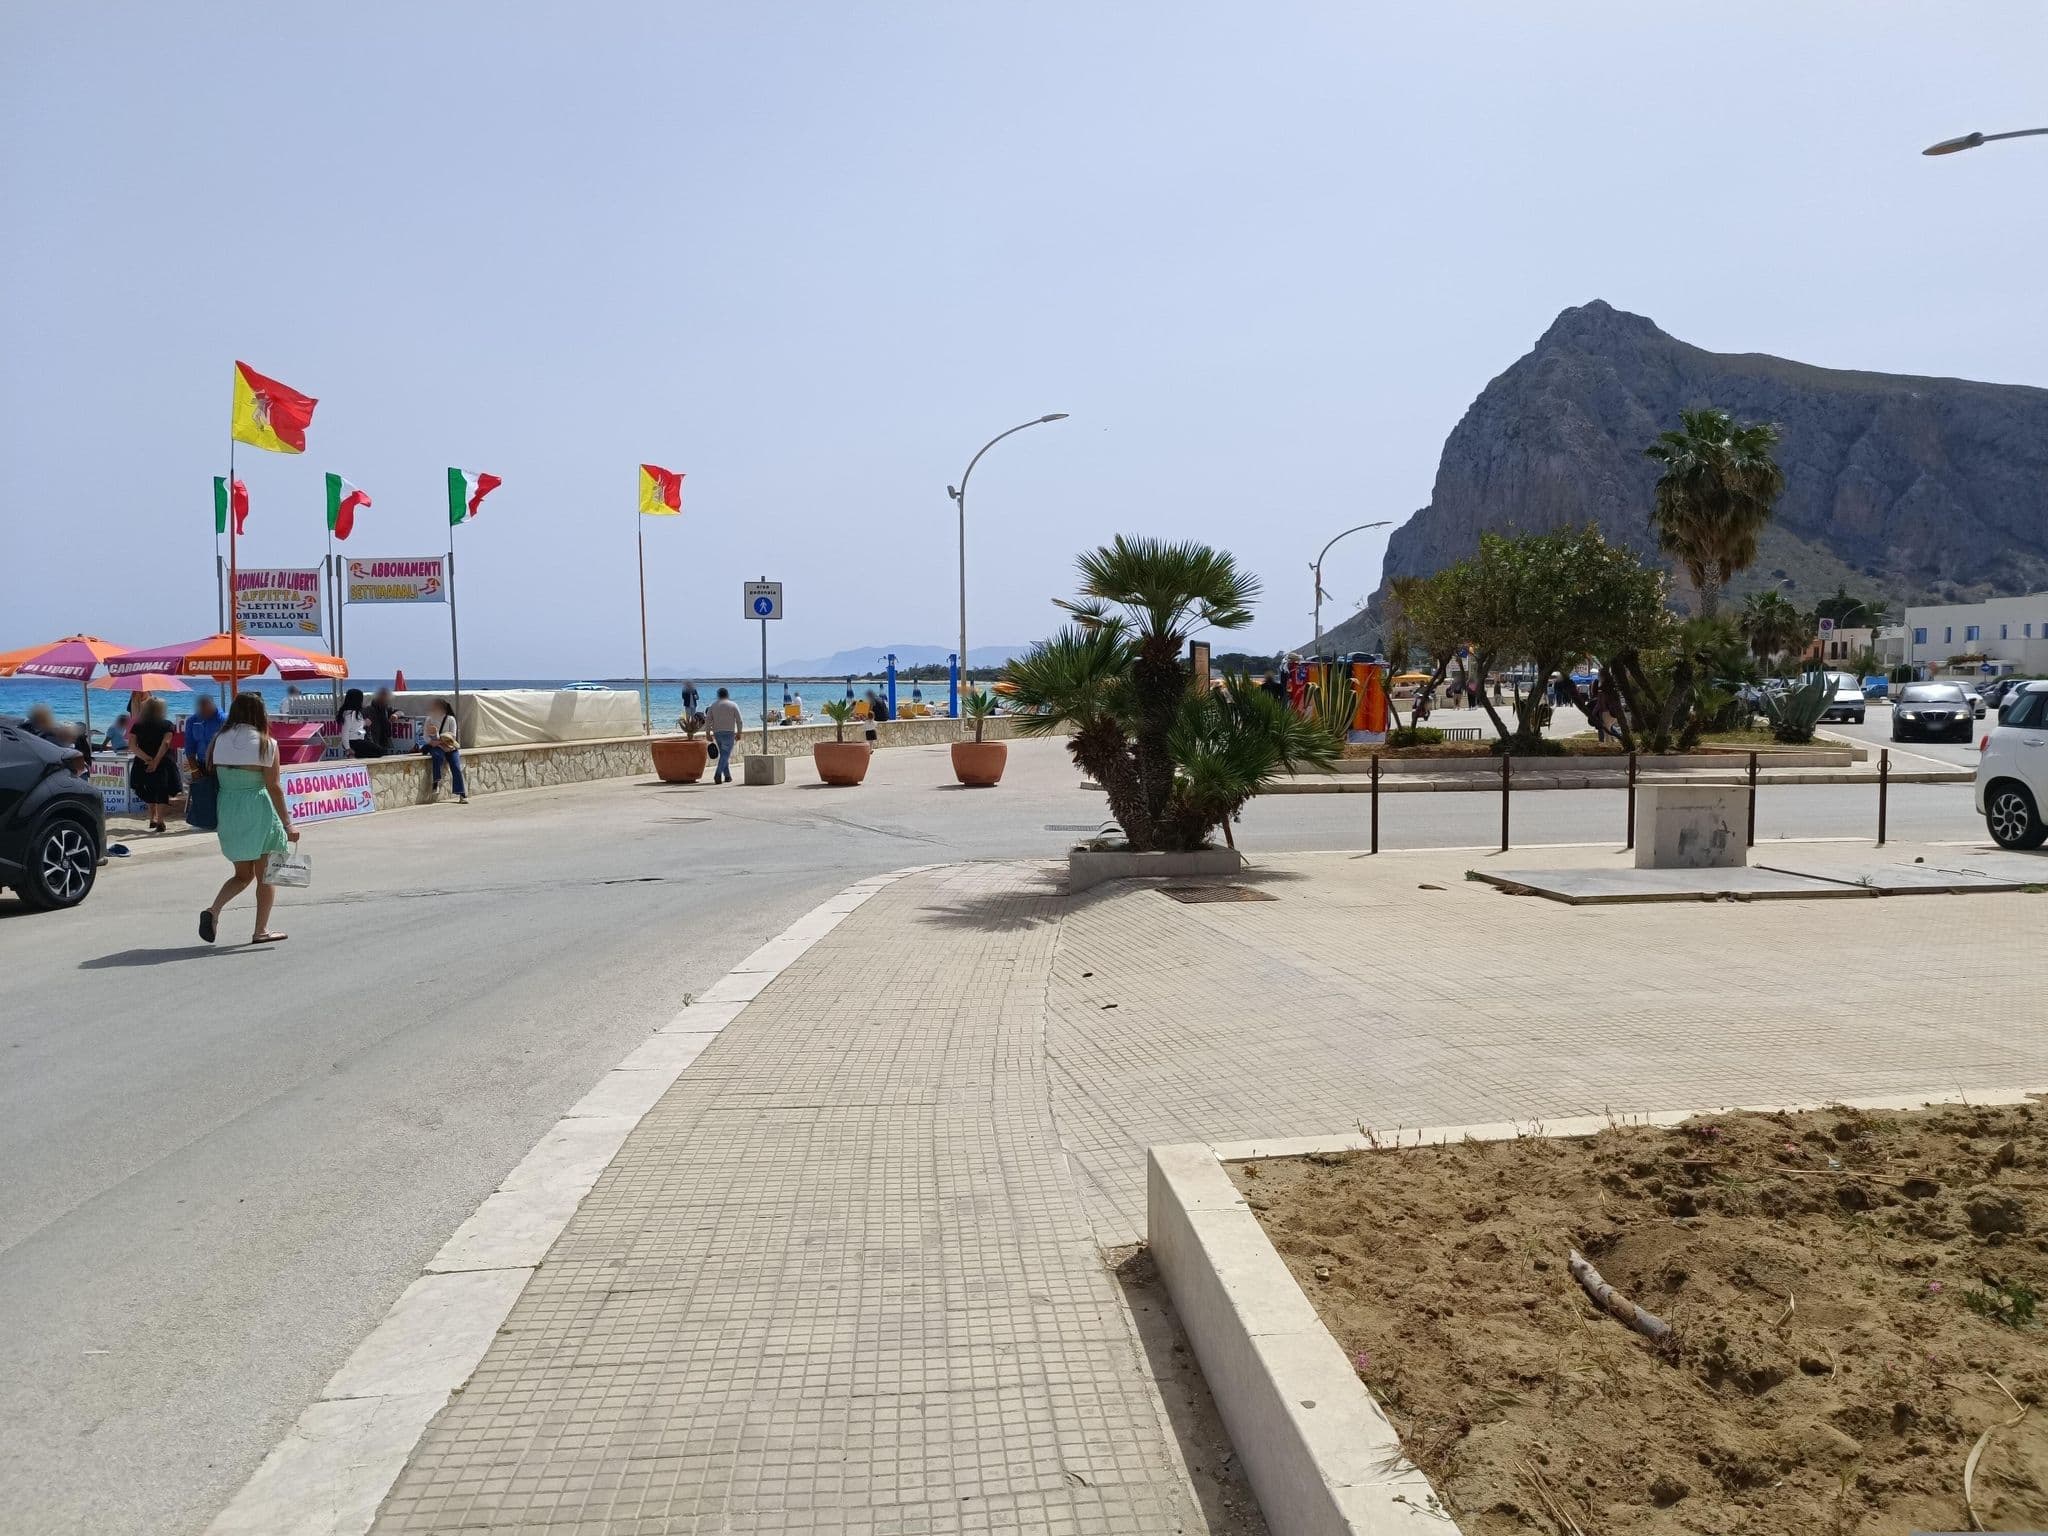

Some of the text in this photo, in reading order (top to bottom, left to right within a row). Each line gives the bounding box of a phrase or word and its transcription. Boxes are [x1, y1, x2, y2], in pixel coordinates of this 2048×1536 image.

[371, 561, 441, 578] ABBONAMENTI
[287, 572, 318, 592] LIBERTI
[241, 589, 301, 602] AFFITTA
[236, 612, 310, 620] OMBRELLONI
[109, 661, 171, 674] CARDINALE
[287, 771, 368, 796] ABBONAMENTI
[292, 796, 357, 819] SETTIMANALI
